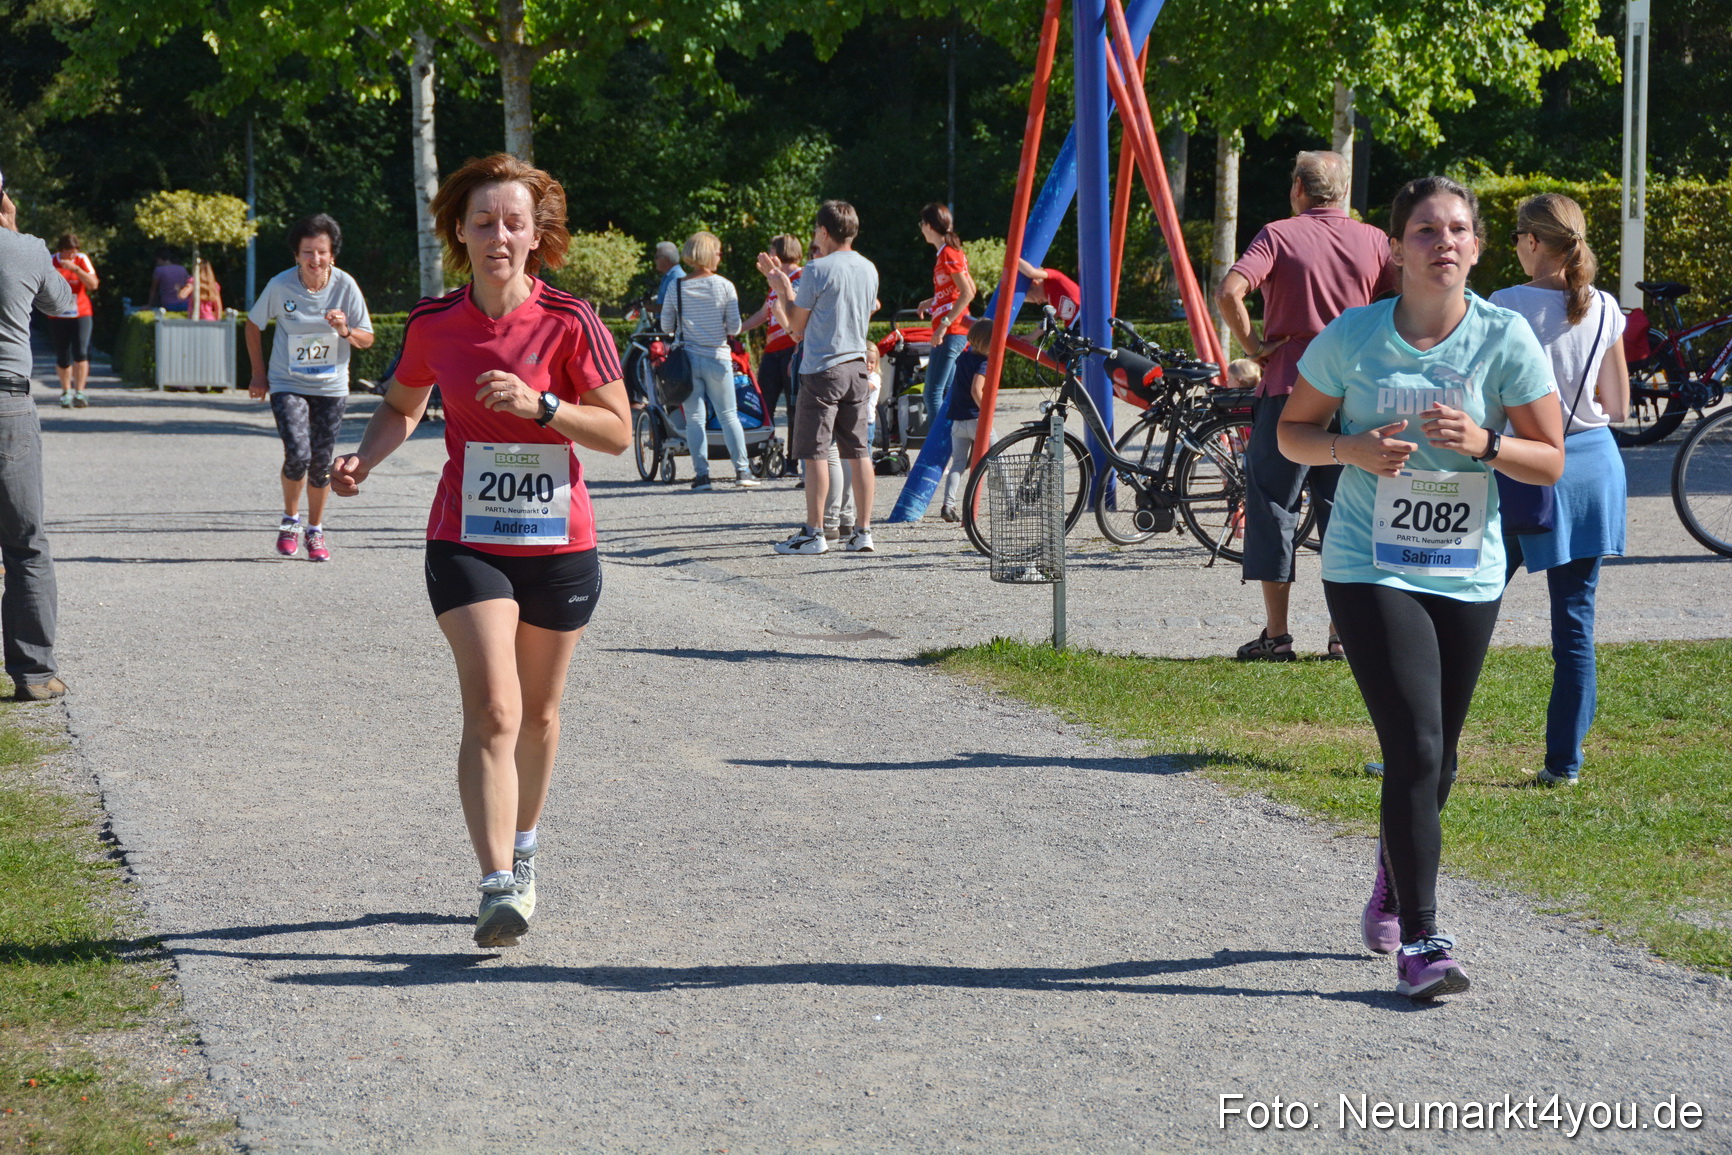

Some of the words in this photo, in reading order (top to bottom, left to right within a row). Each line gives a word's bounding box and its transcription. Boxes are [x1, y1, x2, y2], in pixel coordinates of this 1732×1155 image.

[296, 345, 329, 360] 2127
[1377, 388, 1464, 415] PUMA
[495, 453, 540, 464] BOCK
[478, 472, 554, 503] 2040
[1412, 480, 1459, 493] BOCK
[485, 506, 507, 514] PARTL
[1391, 498, 1471, 533] 2082
[493, 520, 538, 534] Andrea
[1396, 534, 1420, 543] PARTL
[1421, 537, 1453, 545] Neumarkt
[1402, 549, 1451, 564] Sabrina
